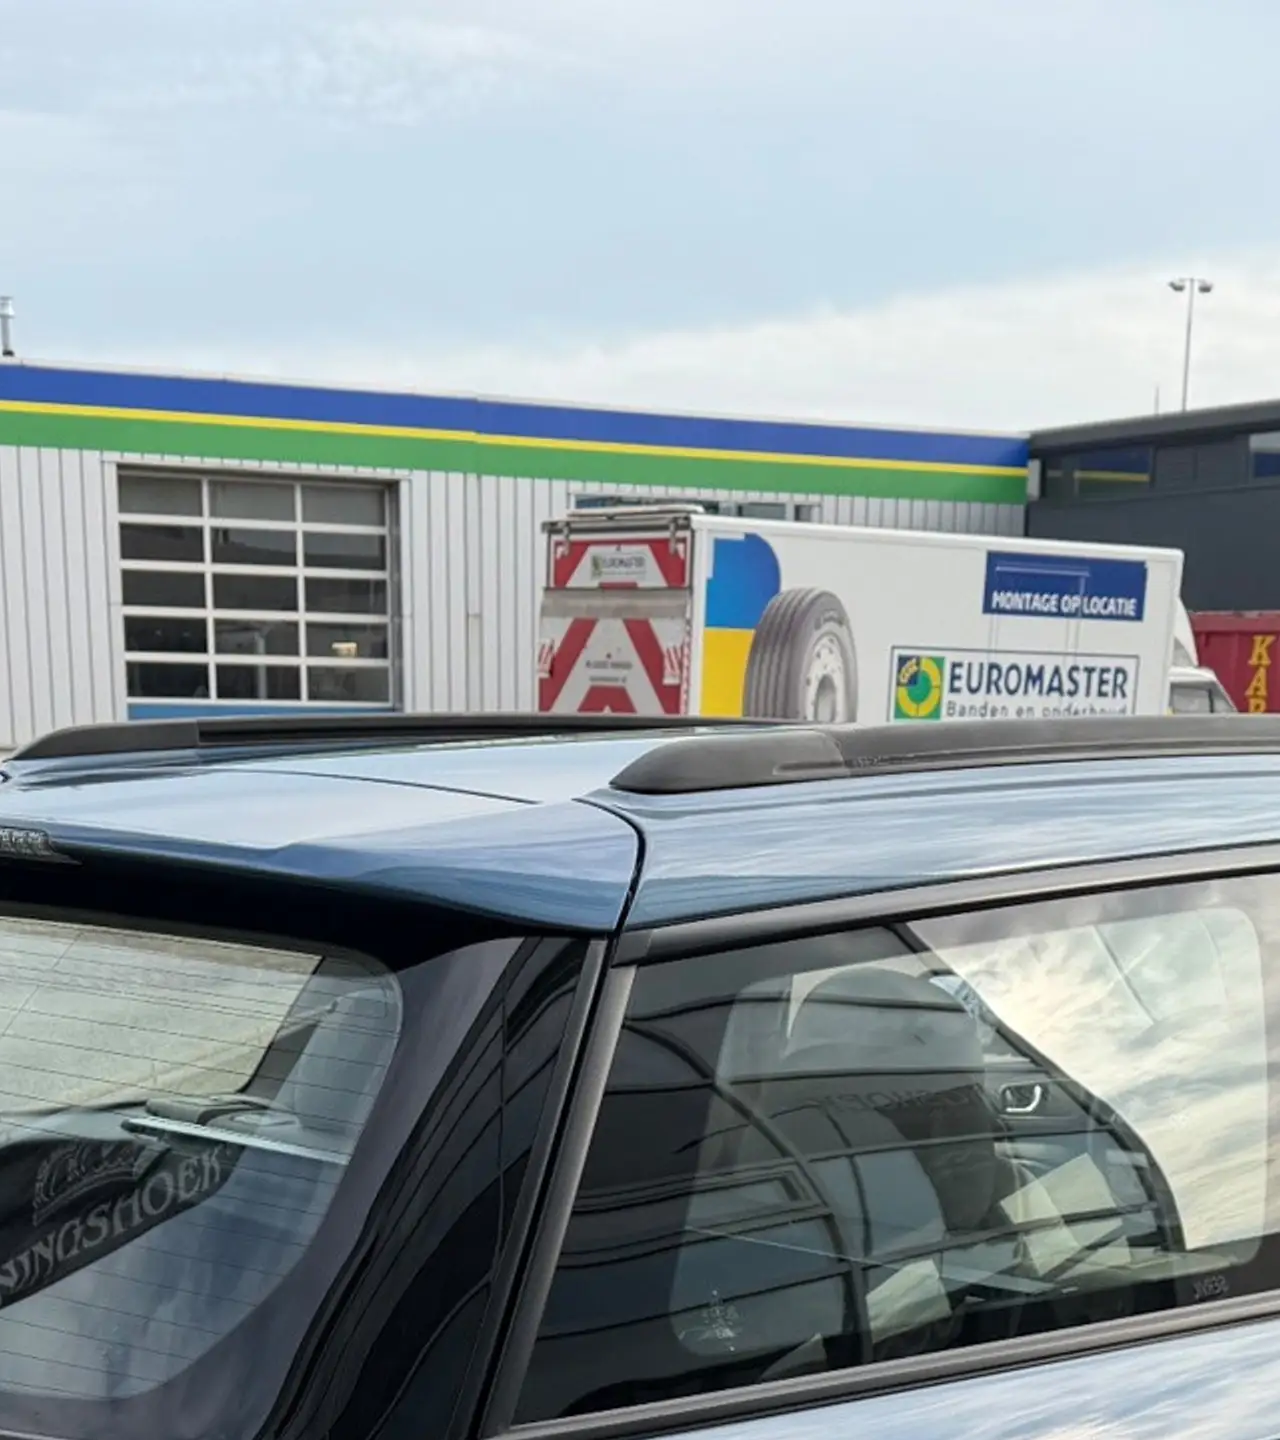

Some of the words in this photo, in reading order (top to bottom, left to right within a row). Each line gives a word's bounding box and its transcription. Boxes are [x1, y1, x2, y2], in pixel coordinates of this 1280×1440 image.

[992, 590, 1059, 613] MONTAGE
[1061, 597, 1081, 614] OP
[1083, 596, 1137, 616] LOCATIE
[948, 661, 1129, 699] EUROMASTER
[947, 701, 1010, 718] Banden
[1016, 705, 1037, 718] en
